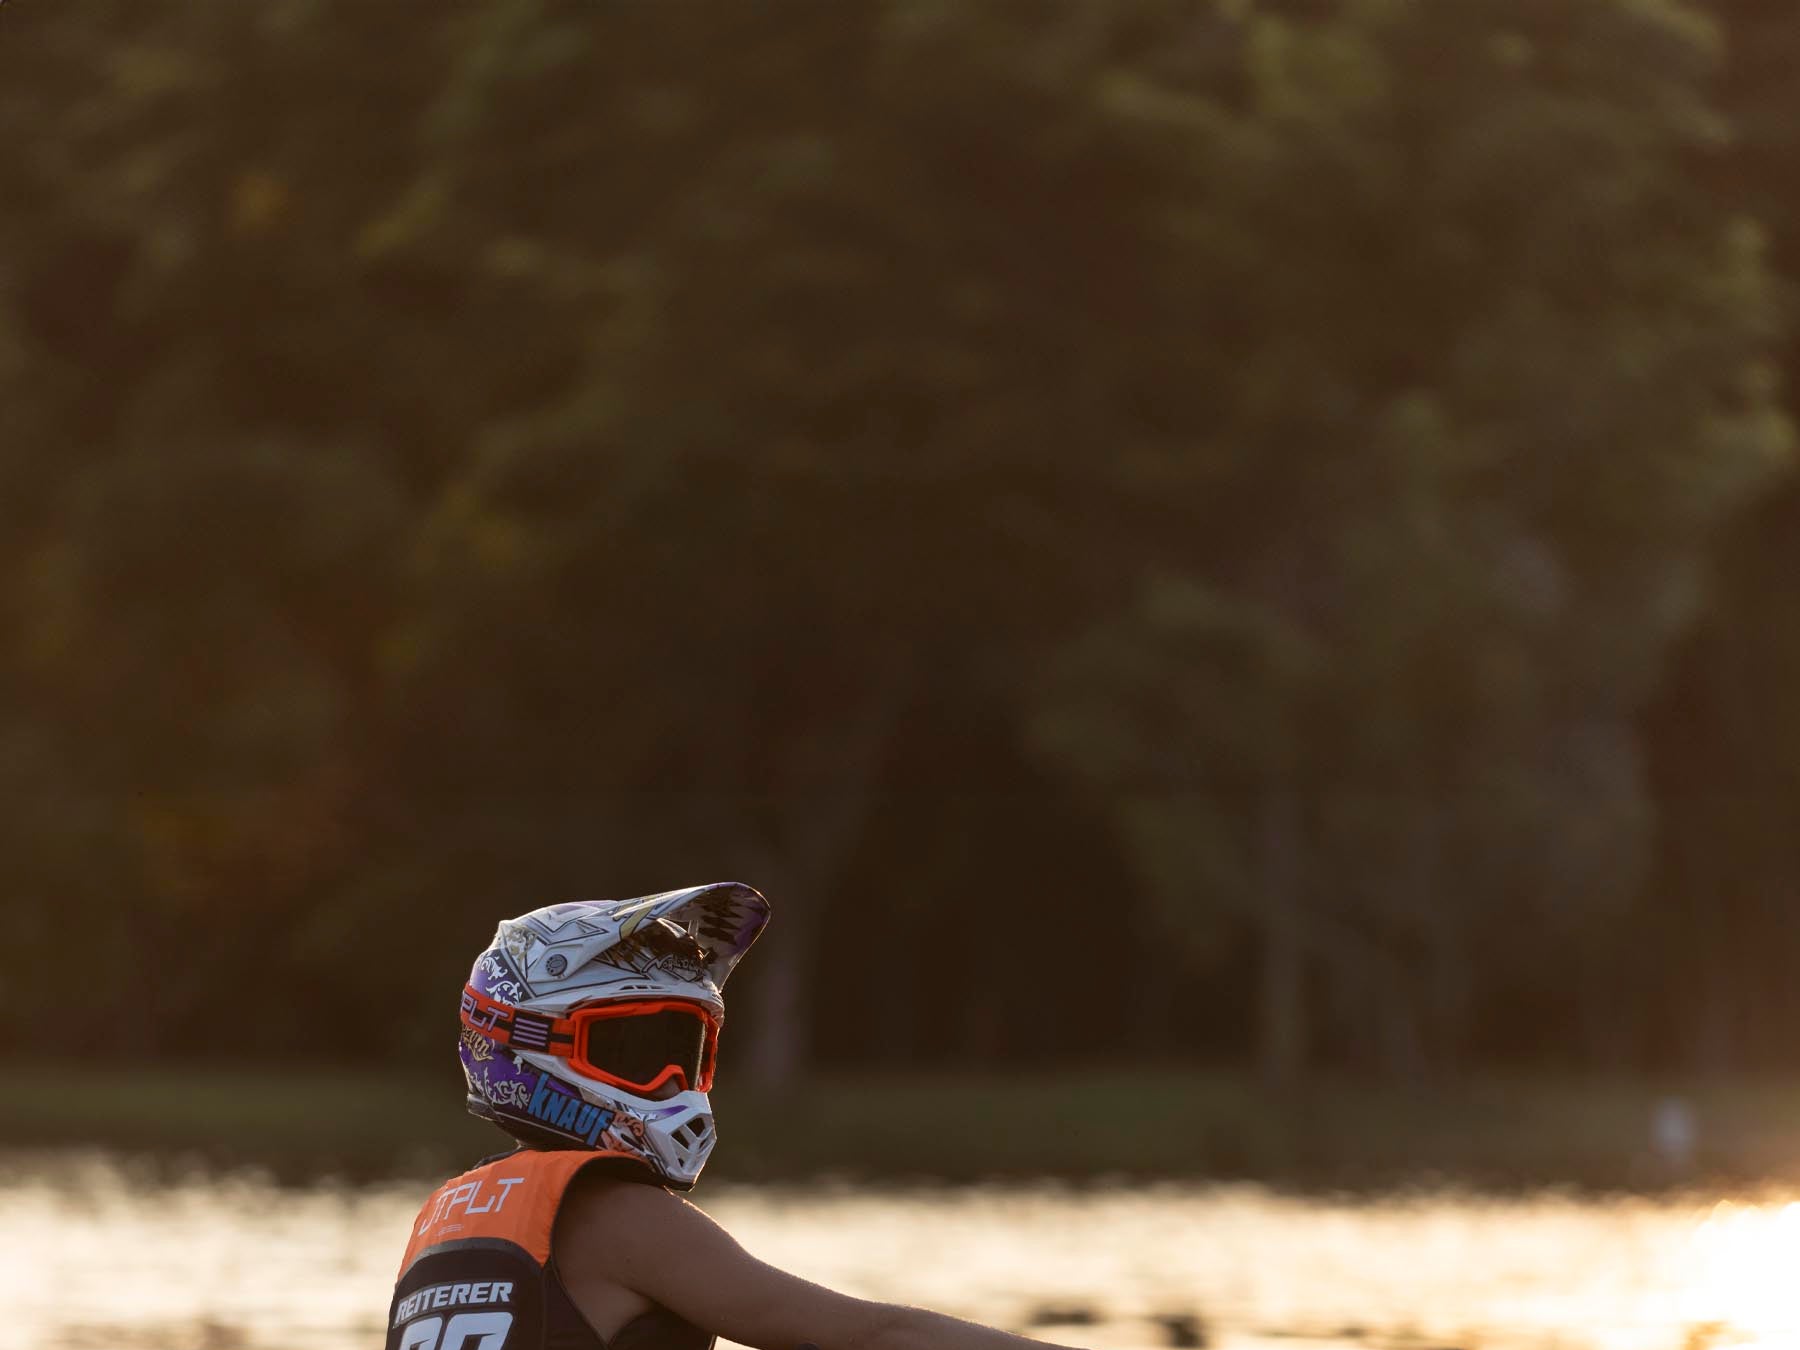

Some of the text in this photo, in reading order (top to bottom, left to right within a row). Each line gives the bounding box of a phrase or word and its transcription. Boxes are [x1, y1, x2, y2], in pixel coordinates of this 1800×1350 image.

[527, 1072, 615, 1147] KNAUF
[418, 1178, 525, 1236] JTPLT
[392, 1282, 514, 1329] REITERER
